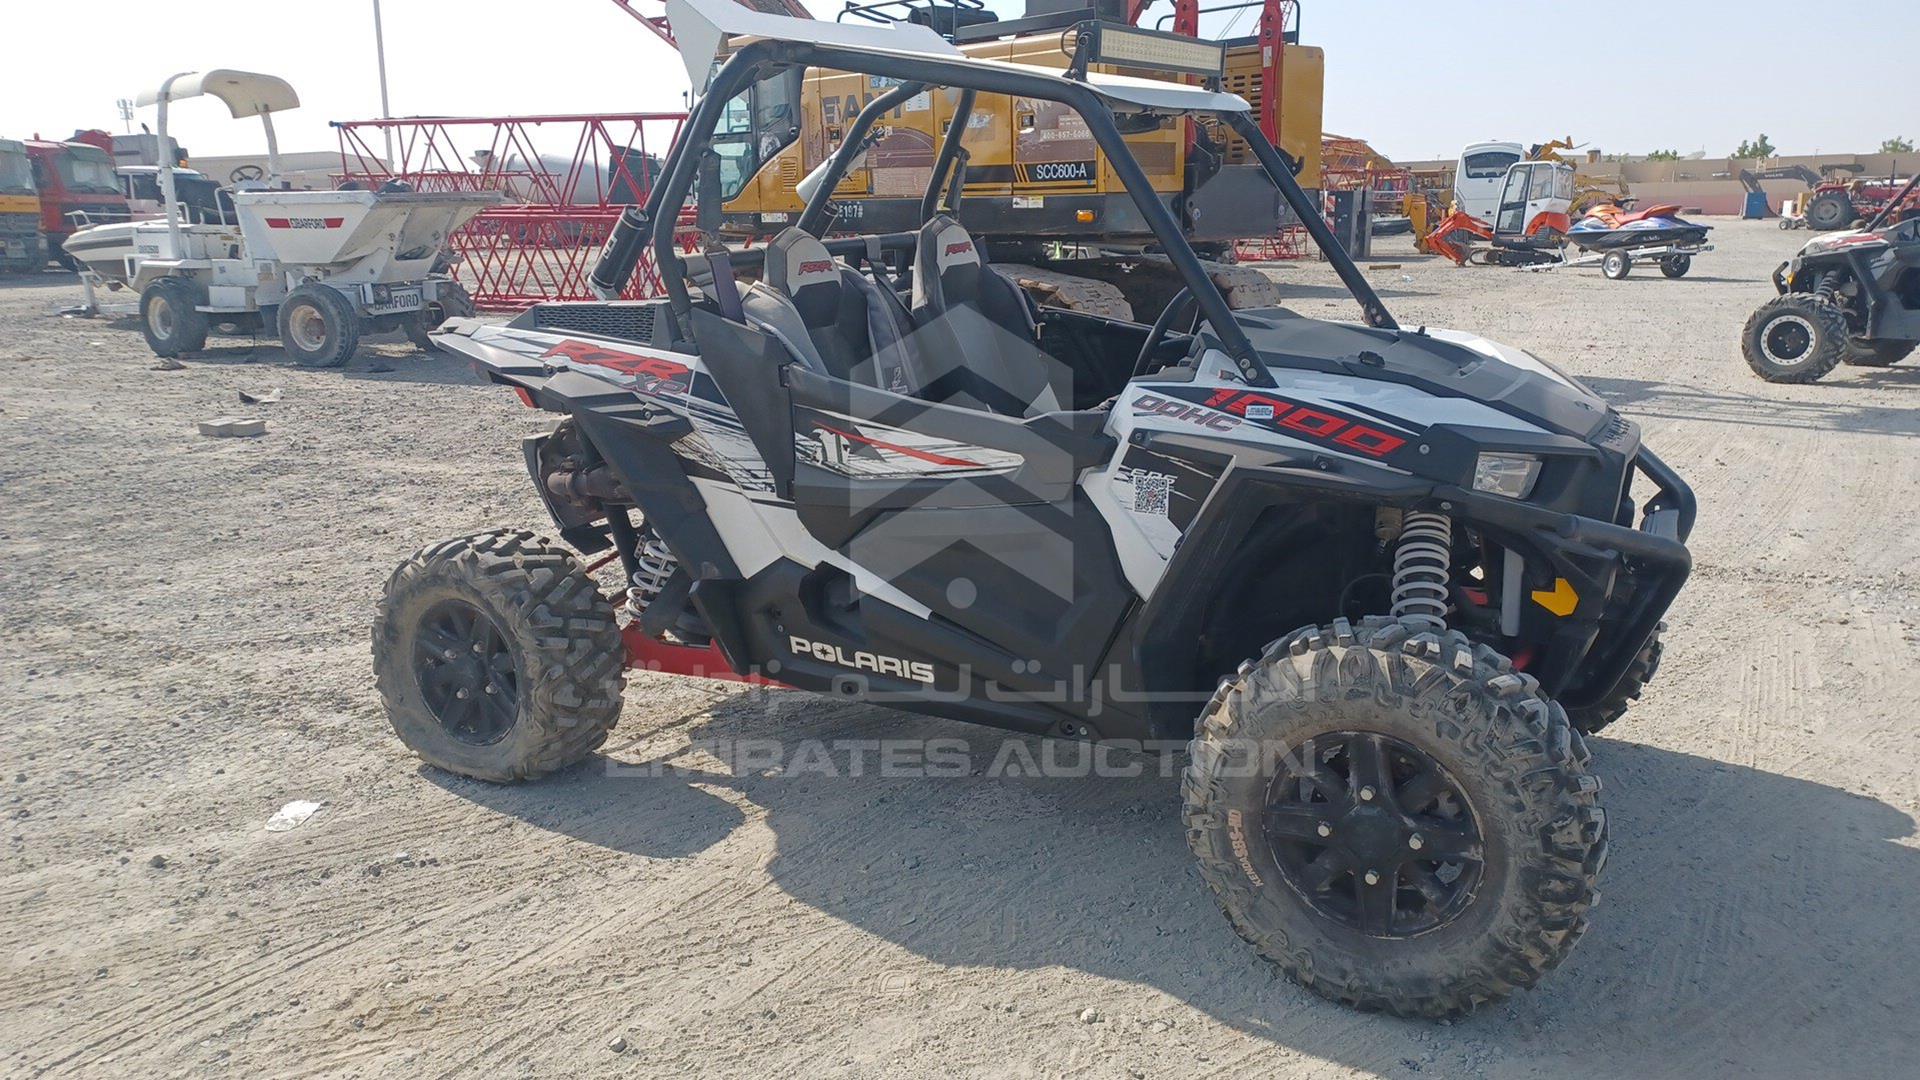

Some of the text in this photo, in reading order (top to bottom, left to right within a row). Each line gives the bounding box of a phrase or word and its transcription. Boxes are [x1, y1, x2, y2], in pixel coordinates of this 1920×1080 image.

[1036, 163, 1087, 179] SCC600-A
[539, 339, 689, 380] RZR
[623, 373, 688, 396] XP
[1131, 394, 1242, 432] DOHC
[1204, 388, 1407, 457] 1000
[789, 635, 935, 683] POLARIS
[1240, 857, 1264, 887] KENDA
